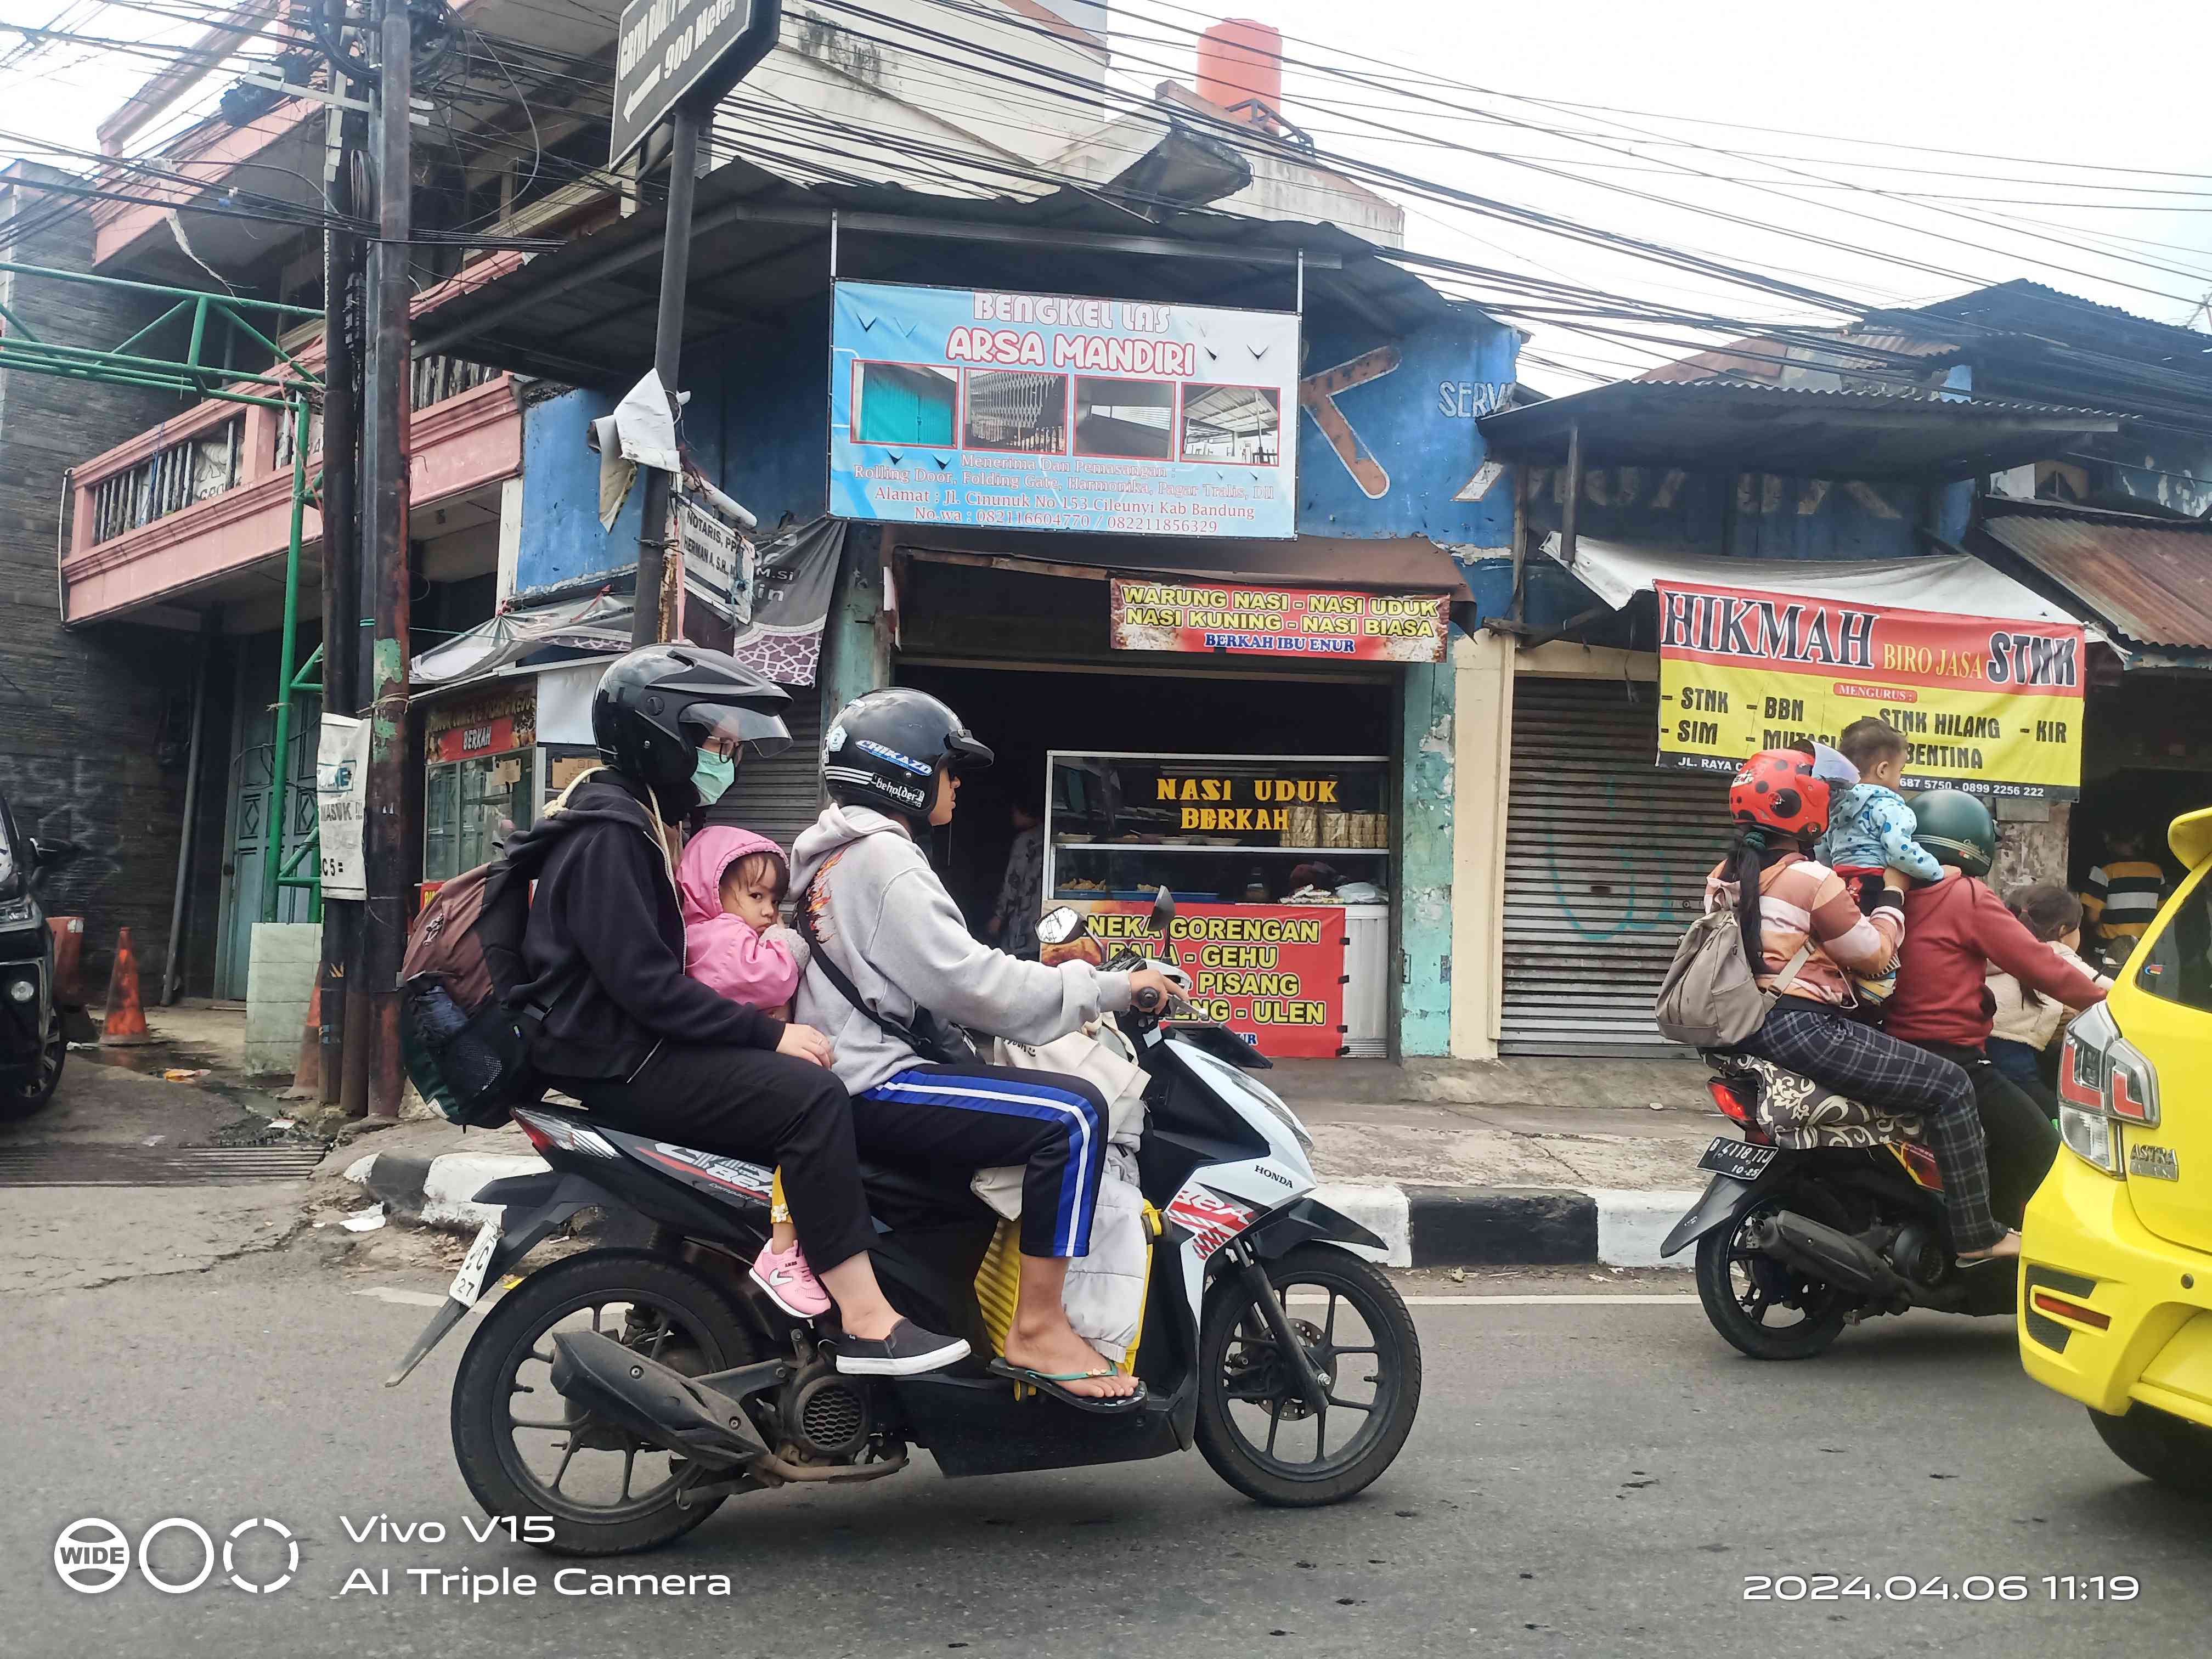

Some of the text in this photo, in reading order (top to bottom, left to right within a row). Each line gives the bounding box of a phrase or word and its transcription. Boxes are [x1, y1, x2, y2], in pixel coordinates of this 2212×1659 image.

[664, 25, 693, 80] 900
[973, 292, 1171, 334] BENGKEL LAS
[946, 326, 1195, 376] ARSA MANDIRI
[961, 454, 1036, 470] Menerima
[1041, 458, 1070, 472] Dan
[1075, 460, 1167, 479] Pemasangan
[854, 465, 909, 483] Rolling
[915, 469, 957, 484] Door,
[962, 471, 1019, 488] Folding
[1024, 474, 1063, 490] Gate,
[1068, 477, 1153, 495] Harmonika,
[1159, 482, 1198, 498] Pagar
[1203, 484, 1247, 500] Tralis,
[875, 487, 929, 502] Alamat
[966, 492, 1030, 507] Cinunuk
[1036, 495, 1055, 509] No
[1062, 497, 1088, 510] 153
[1093, 498, 1154, 515] Cileunyi
[1160, 502, 1186, 515] Kab
[1192, 504, 1255, 520] Bandung
[915, 507, 962, 521] No.wa
[977, 510, 1090, 528] 082116604770
[1108, 516, 1217, 533] 082211856329
[1122, 586, 1227, 608] WARUNG
[1233, 592, 1289, 611] NASI
[1309, 595, 1364, 615] NASI
[1370, 599, 1440, 618] UDUK
[1126, 607, 1182, 627] NASI
[1189, 610, 1282, 631] KUNING
[1302, 616, 1357, 634] NASI
[1364, 618, 1435, 638] BIASA
[1205, 633, 1355, 652] BERKAH IBU ENUR
[1660, 588, 2078, 687] HIKMAH BIRO JASA STNK
[1680, 686, 1729, 714] STNK
[1764, 697, 1804, 722] BBN
[1879, 708, 1927, 733] STNK
[1934, 713, 2001, 739] HILANG
[2036, 720, 2067, 743] KIR
[463, 726, 492, 752] BERKAH
[1677, 720, 1718, 745] SIM
[1905, 743, 1983, 769] BENTINA
[1678, 757, 1697, 768] JL.
[1701, 759, 1732, 771] RAYA
[1156, 778, 1339, 803] NASI UDUK
[1924, 780, 1953, 791] 5750
[1962, 782, 1990, 793] 0899
[1993, 785, 2021, 796] 2256
[2023, 787, 2044, 797] 222
[1180, 808, 1290, 831] BERKAH
[1170, 917, 1320, 943] GORENGAN
[1202, 945, 1278, 968] GEHU
[1198, 972, 1300, 997] PISANG
[1252, 1001, 1325, 1025] ULEN
[2130, 1144, 2177, 1165] ASTRA
[1254, 1165, 1293, 1189] HONDA
